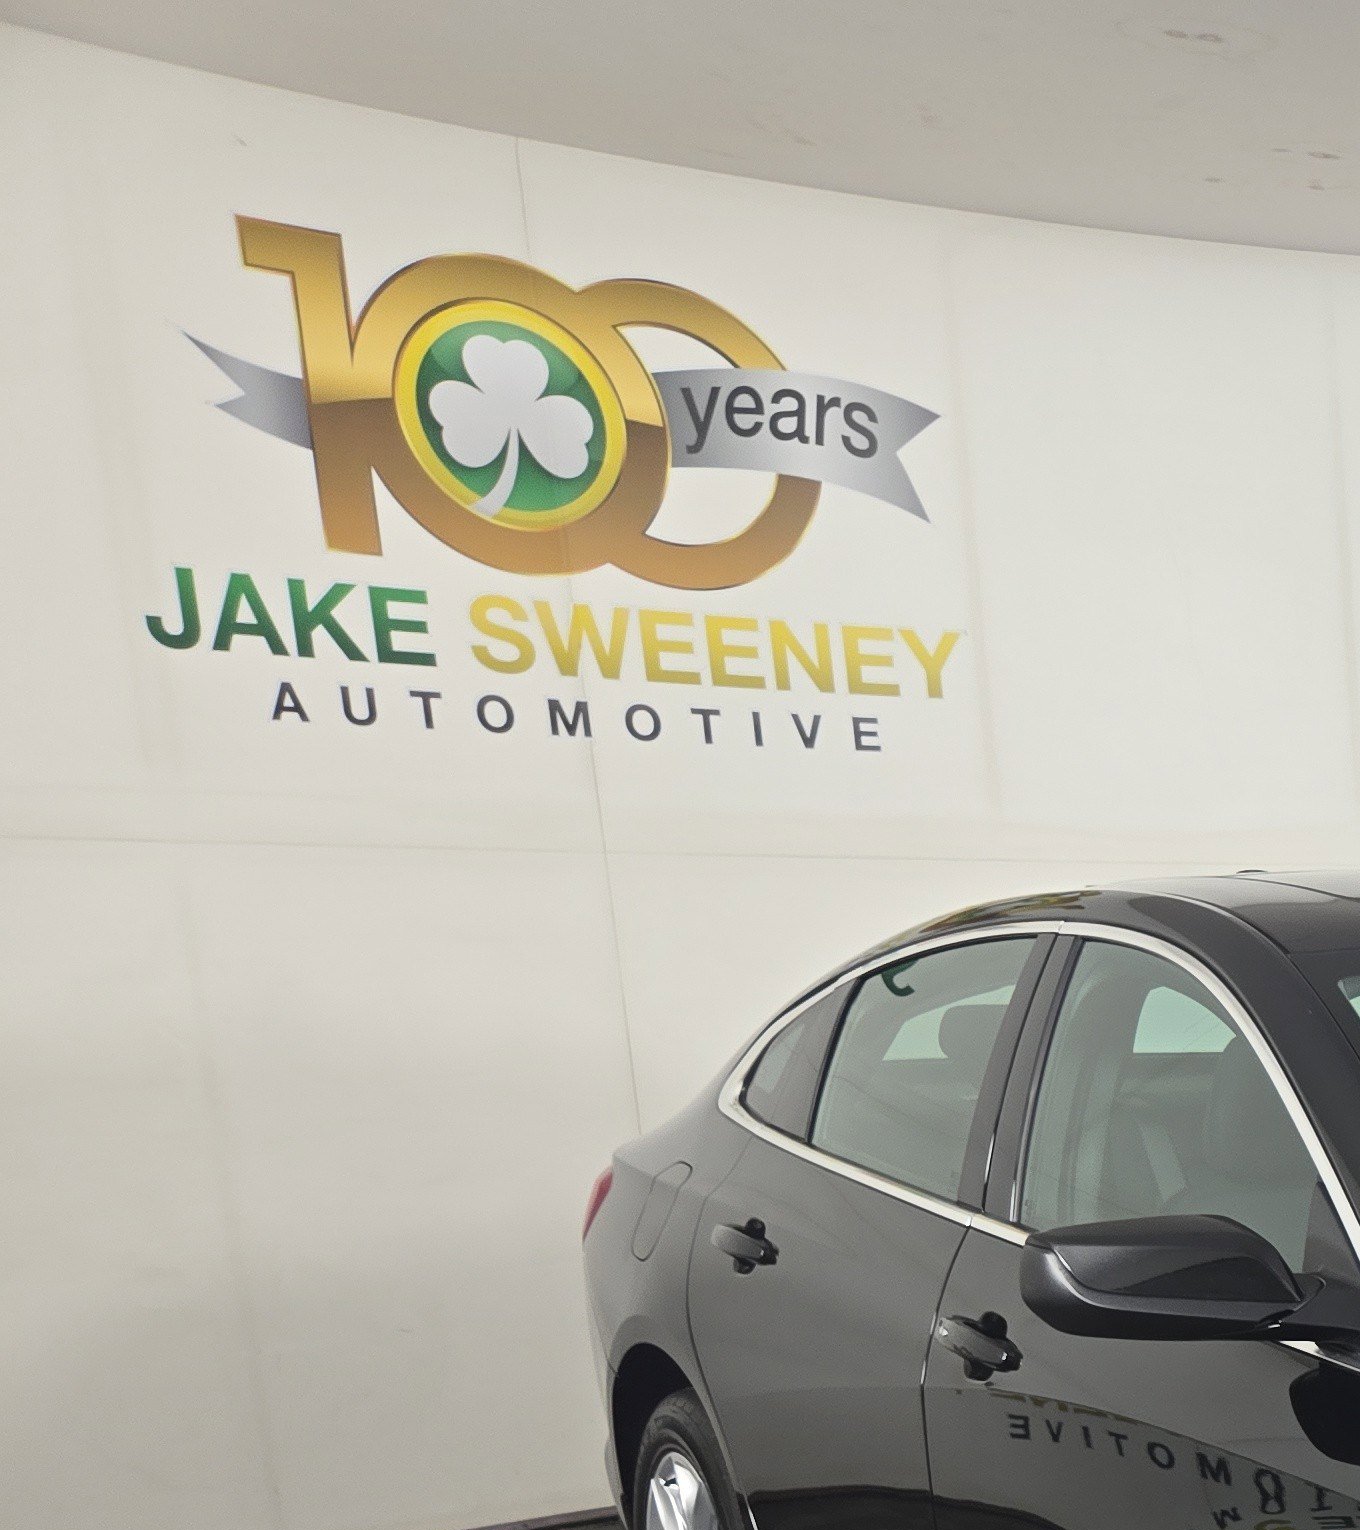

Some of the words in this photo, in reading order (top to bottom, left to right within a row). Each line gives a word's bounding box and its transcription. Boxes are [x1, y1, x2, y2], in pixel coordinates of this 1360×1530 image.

[680, 379, 880, 459] years
[145, 565, 437, 667] JAKE
[470, 595, 960, 700] SWEENEY
[271, 681, 882, 752] AUTOMOTIVE
